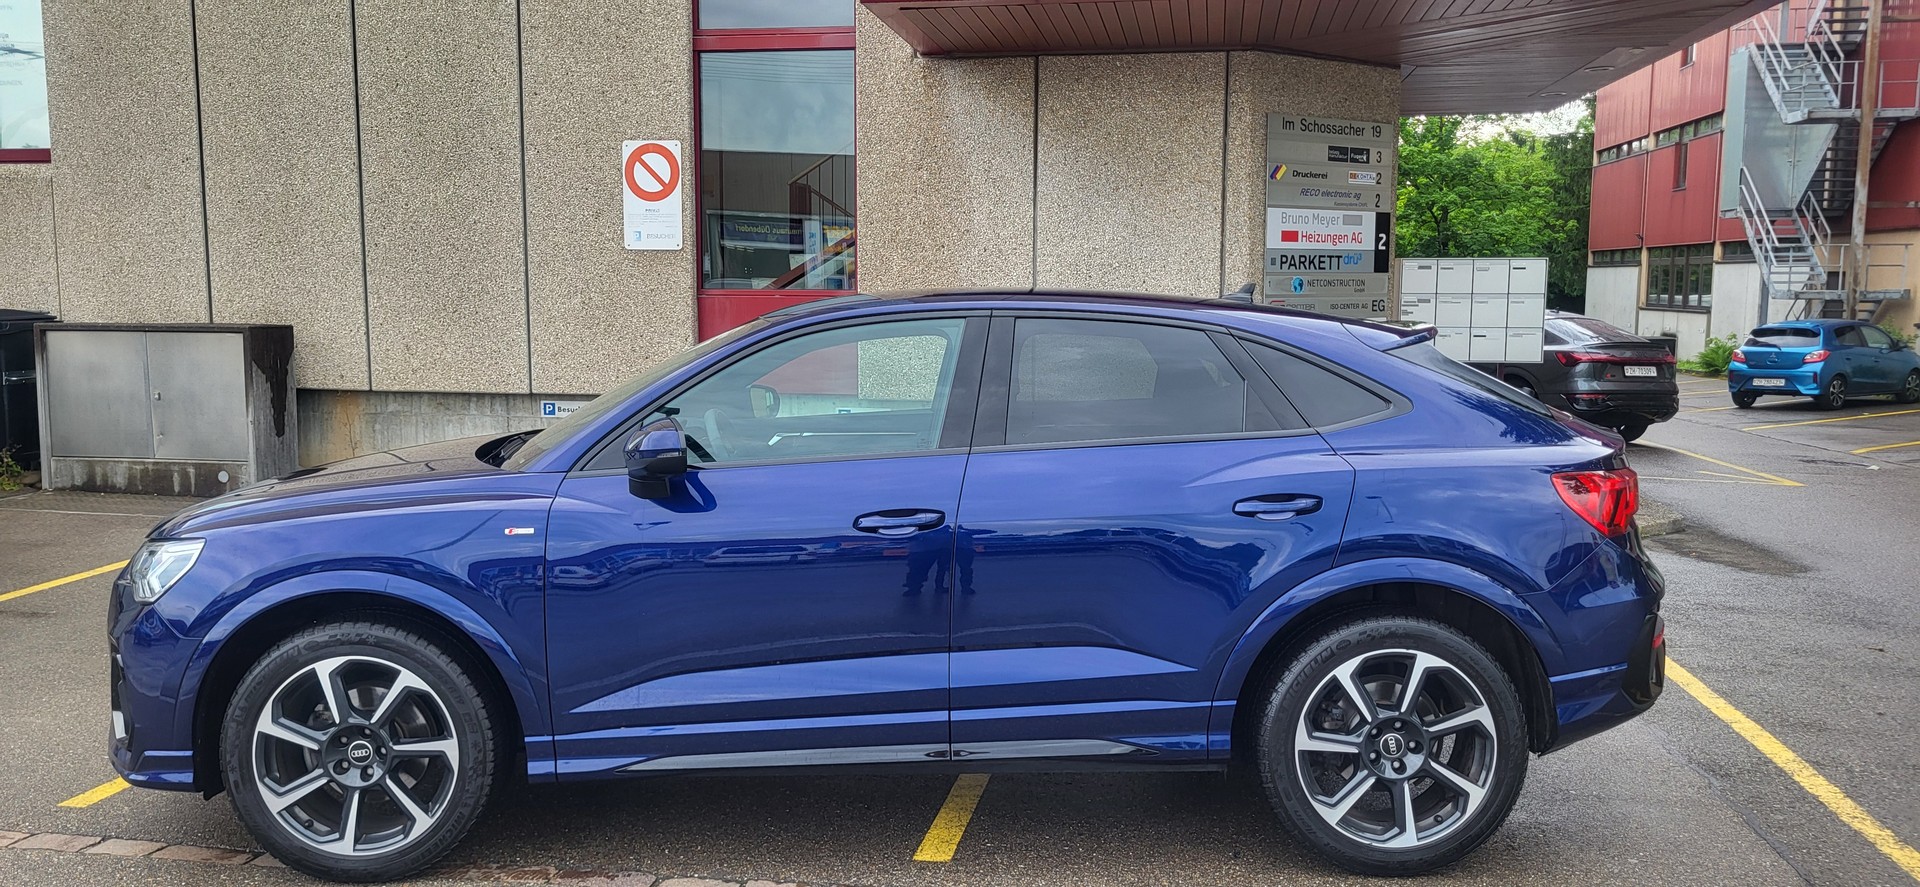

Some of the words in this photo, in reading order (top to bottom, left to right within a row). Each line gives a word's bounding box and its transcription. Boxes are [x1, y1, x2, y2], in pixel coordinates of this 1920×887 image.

[1282, 117, 1295, 131] Im
[1300, 118, 1366, 137] Schossacher
[1371, 125, 1382, 138] 19
[1376, 151, 1382, 164] 3
[1292, 170, 1328, 180] Druckerei
[1376, 173, 1382, 185] 2
[1300, 188, 1320, 197] RECO
[1321, 189, 1353, 199] electronic
[1353, 192, 1362, 200] ag
[1375, 194, 1381, 208] 2
[1281, 212, 1310, 225] Bruno
[1312, 213, 1340, 228] Meyer
[1301, 231, 1349, 247] Heizungen
[1350, 232, 1363, 244] AG
[1378, 233, 1387, 251] 2
[1280, 254, 1343, 270] PARKETT
[1307, 279, 1366, 287] NETCONSTRUCTION
[1371, 300, 1385, 312] EG
